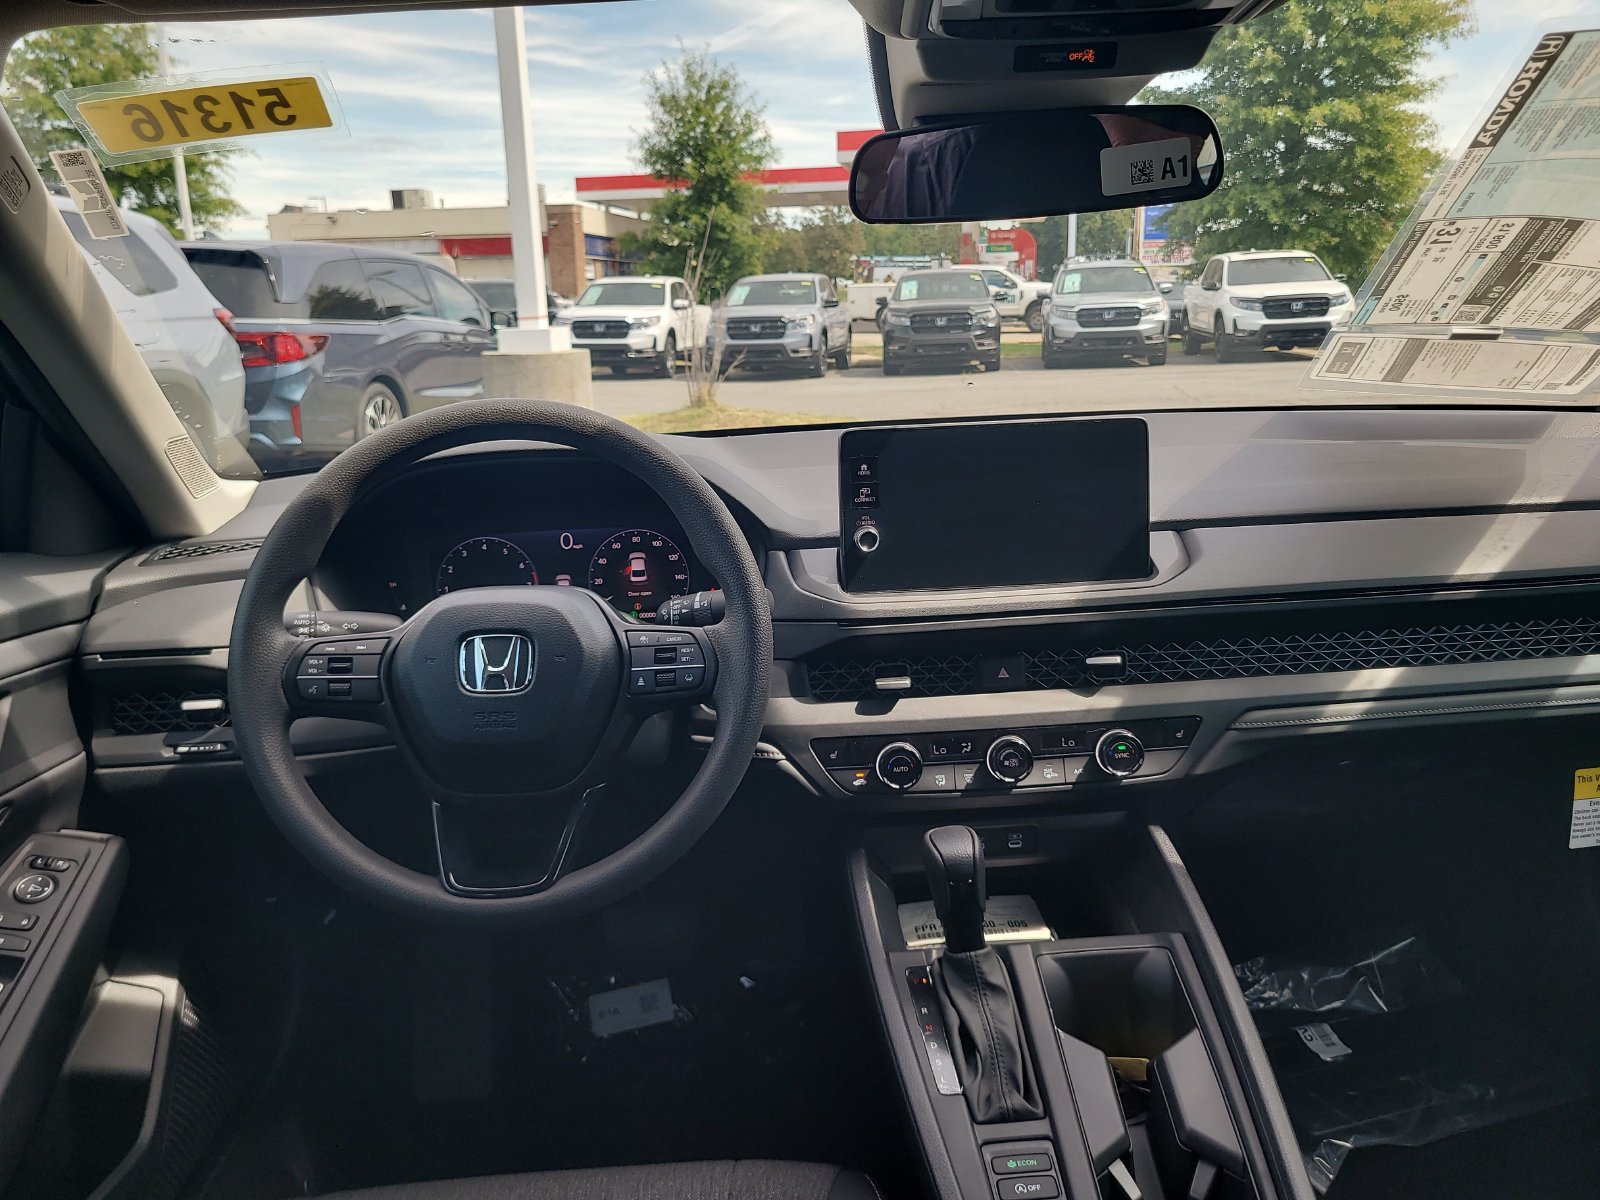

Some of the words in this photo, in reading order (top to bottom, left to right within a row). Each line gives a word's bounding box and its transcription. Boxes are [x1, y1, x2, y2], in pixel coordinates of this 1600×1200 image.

[1069, 52, 1083, 60] OFF
[1160, 154, 1188, 181] A1
[560, 532, 573, 550] 0
[448, 566, 454, 574] 2
[1062, 737, 1076, 747] Lo
[934, 744, 946, 754] Lo
[1578, 776, 1593, 784] This
[1017, 1158, 1037, 1167] ECON
[1028, 1184, 1042, 1192] OFF
